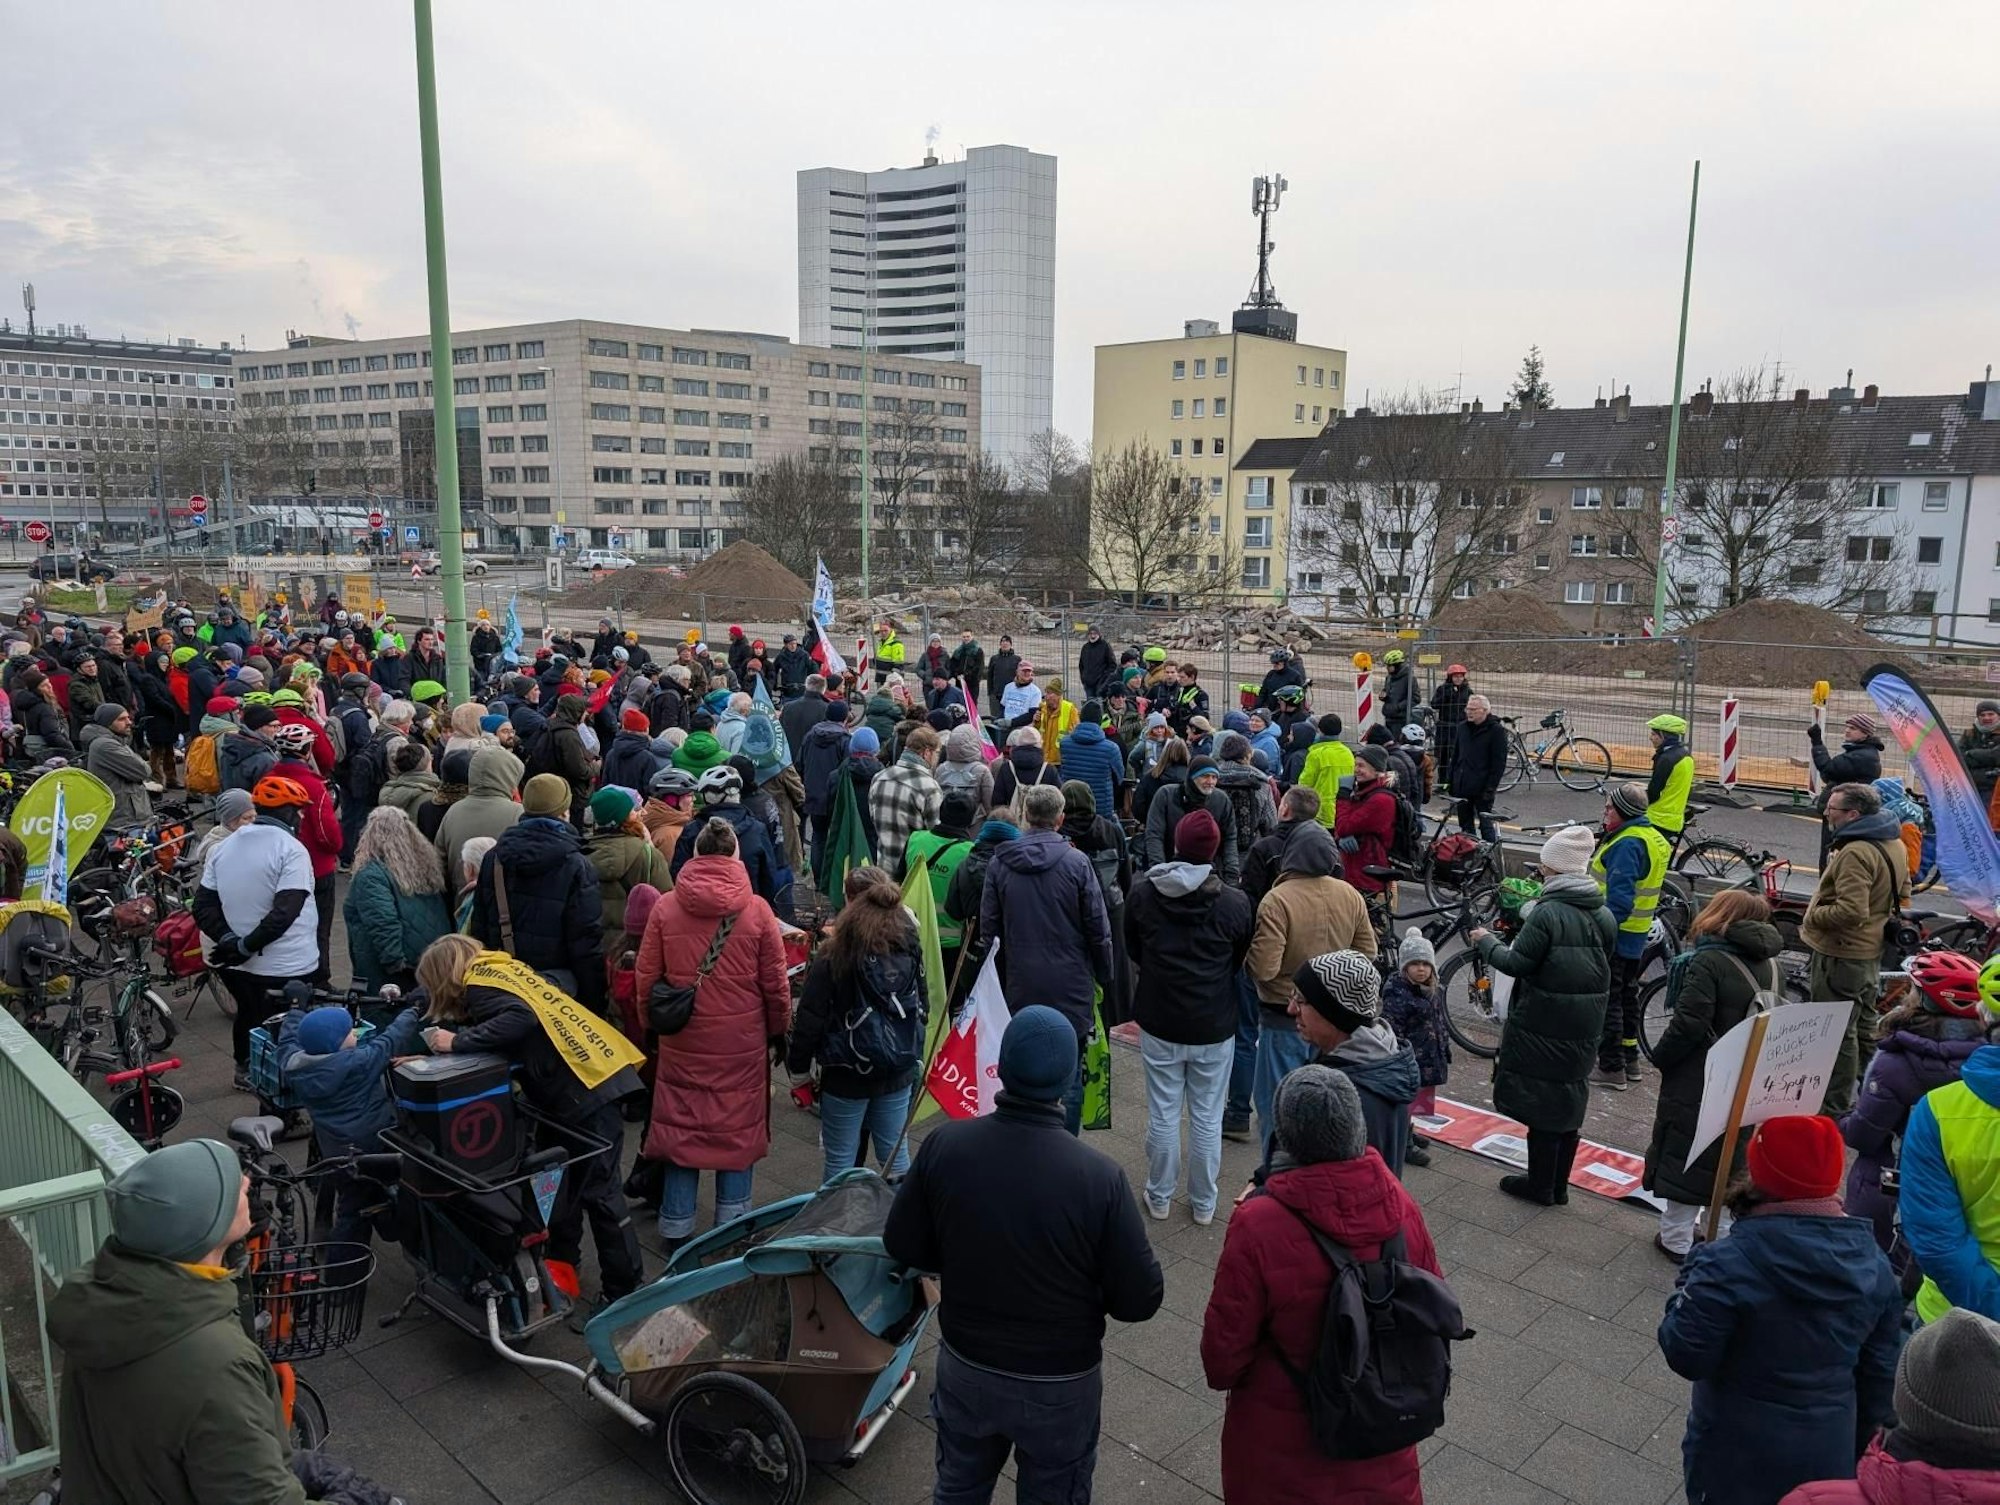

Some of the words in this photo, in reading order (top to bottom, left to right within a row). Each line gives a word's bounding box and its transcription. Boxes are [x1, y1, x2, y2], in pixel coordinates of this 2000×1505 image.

[191, 500, 206, 508] STOP
[370, 516, 382, 524] STOP
[27, 527, 47, 536] STOP
[542, 991, 564, 1006] of
[560, 1005, 614, 1058] Cologne
